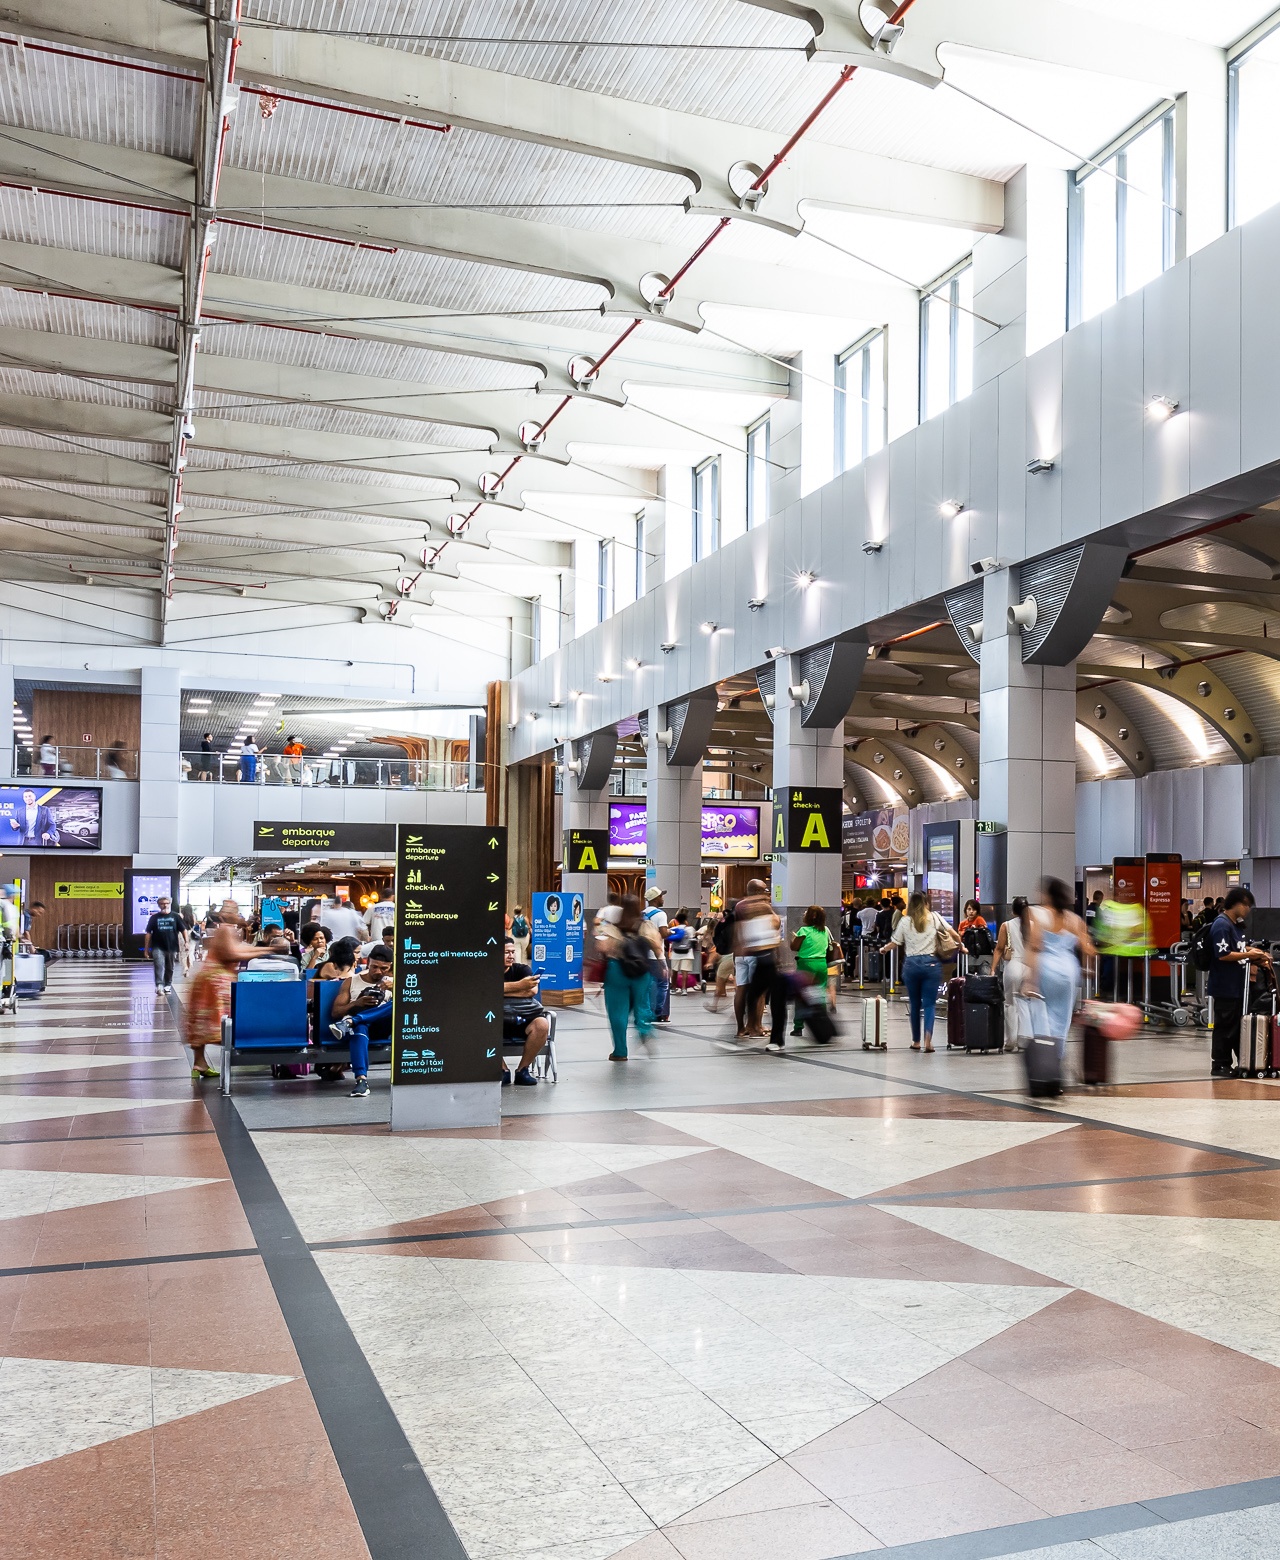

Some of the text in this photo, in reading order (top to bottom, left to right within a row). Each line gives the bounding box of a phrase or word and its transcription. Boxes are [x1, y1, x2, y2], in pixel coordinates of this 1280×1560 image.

[282, 828, 335, 838] embarque
[775, 813, 785, 848] A
[800, 813, 830, 847] A
[282, 838, 330, 847] departure
[405, 847, 446, 855] embarque
[578, 846, 599, 870] A
[404, 912, 459, 920] desembarque
[403, 951, 427, 959] praça
[402, 988, 421, 996] lojas
[401, 1059, 425, 1067] metrô
